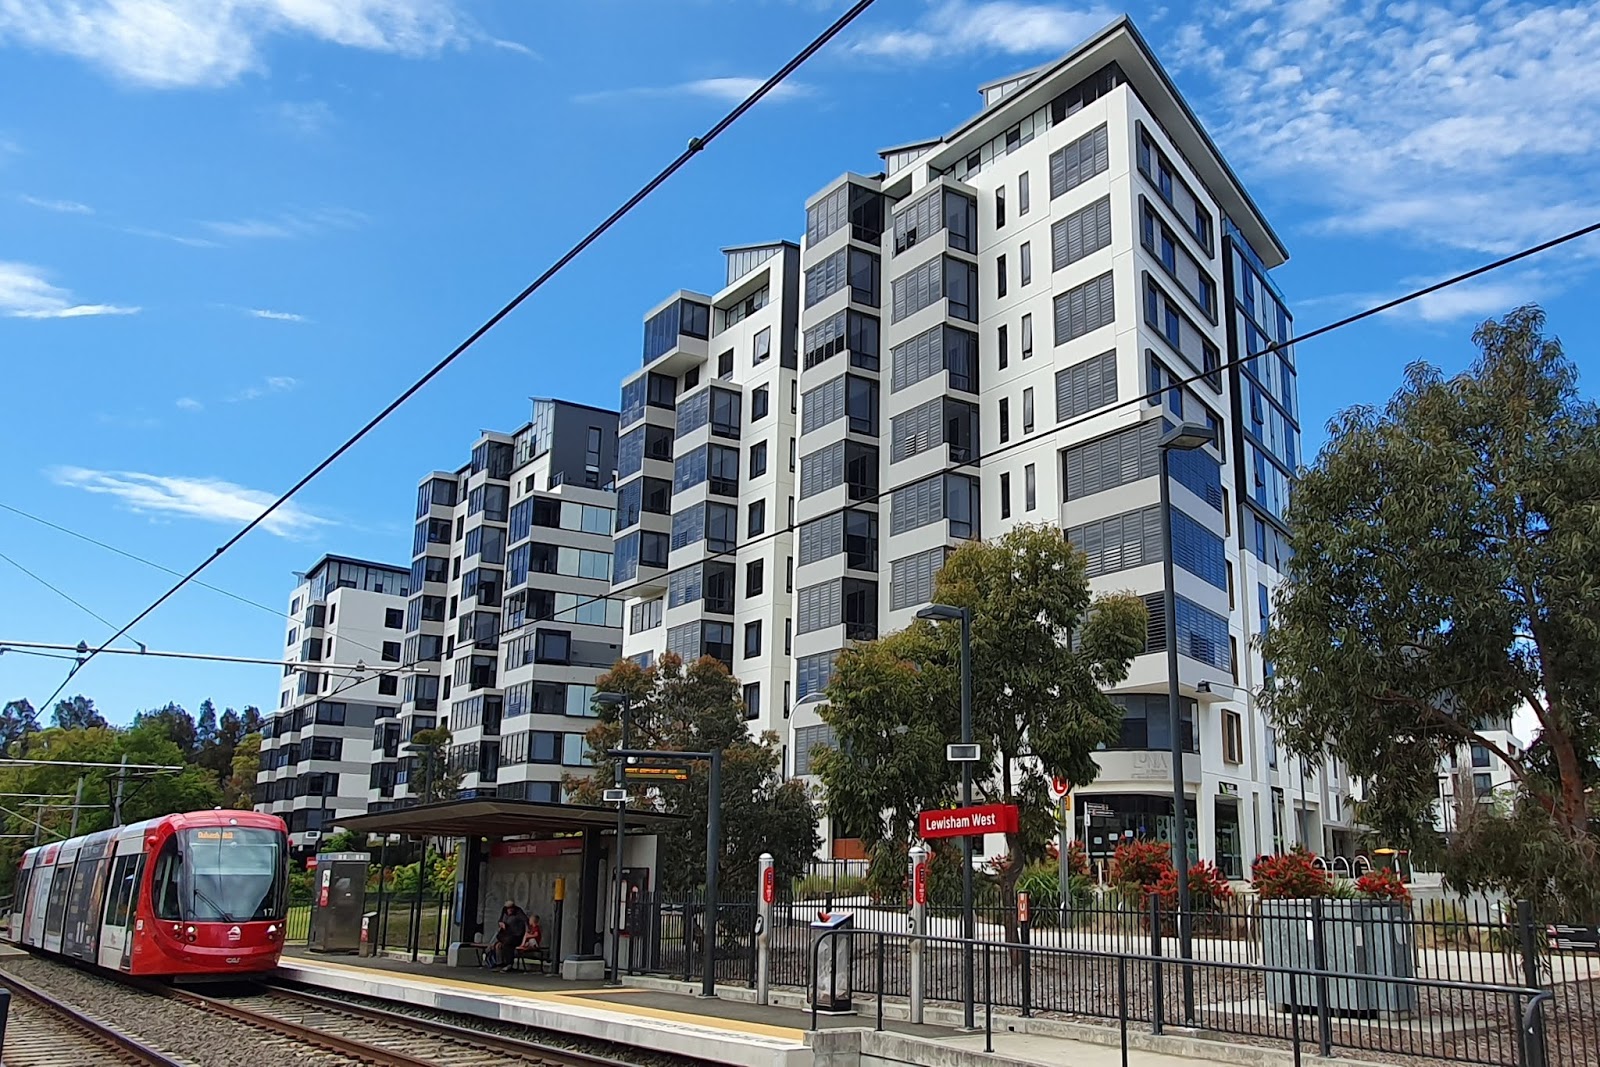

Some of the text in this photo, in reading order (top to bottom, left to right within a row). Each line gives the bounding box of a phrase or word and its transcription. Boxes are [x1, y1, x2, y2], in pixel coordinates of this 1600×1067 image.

[1057, 778, 1064, 790] L
[926, 812, 996, 831] Lewisham West
[263, 908, 274, 917] 17
